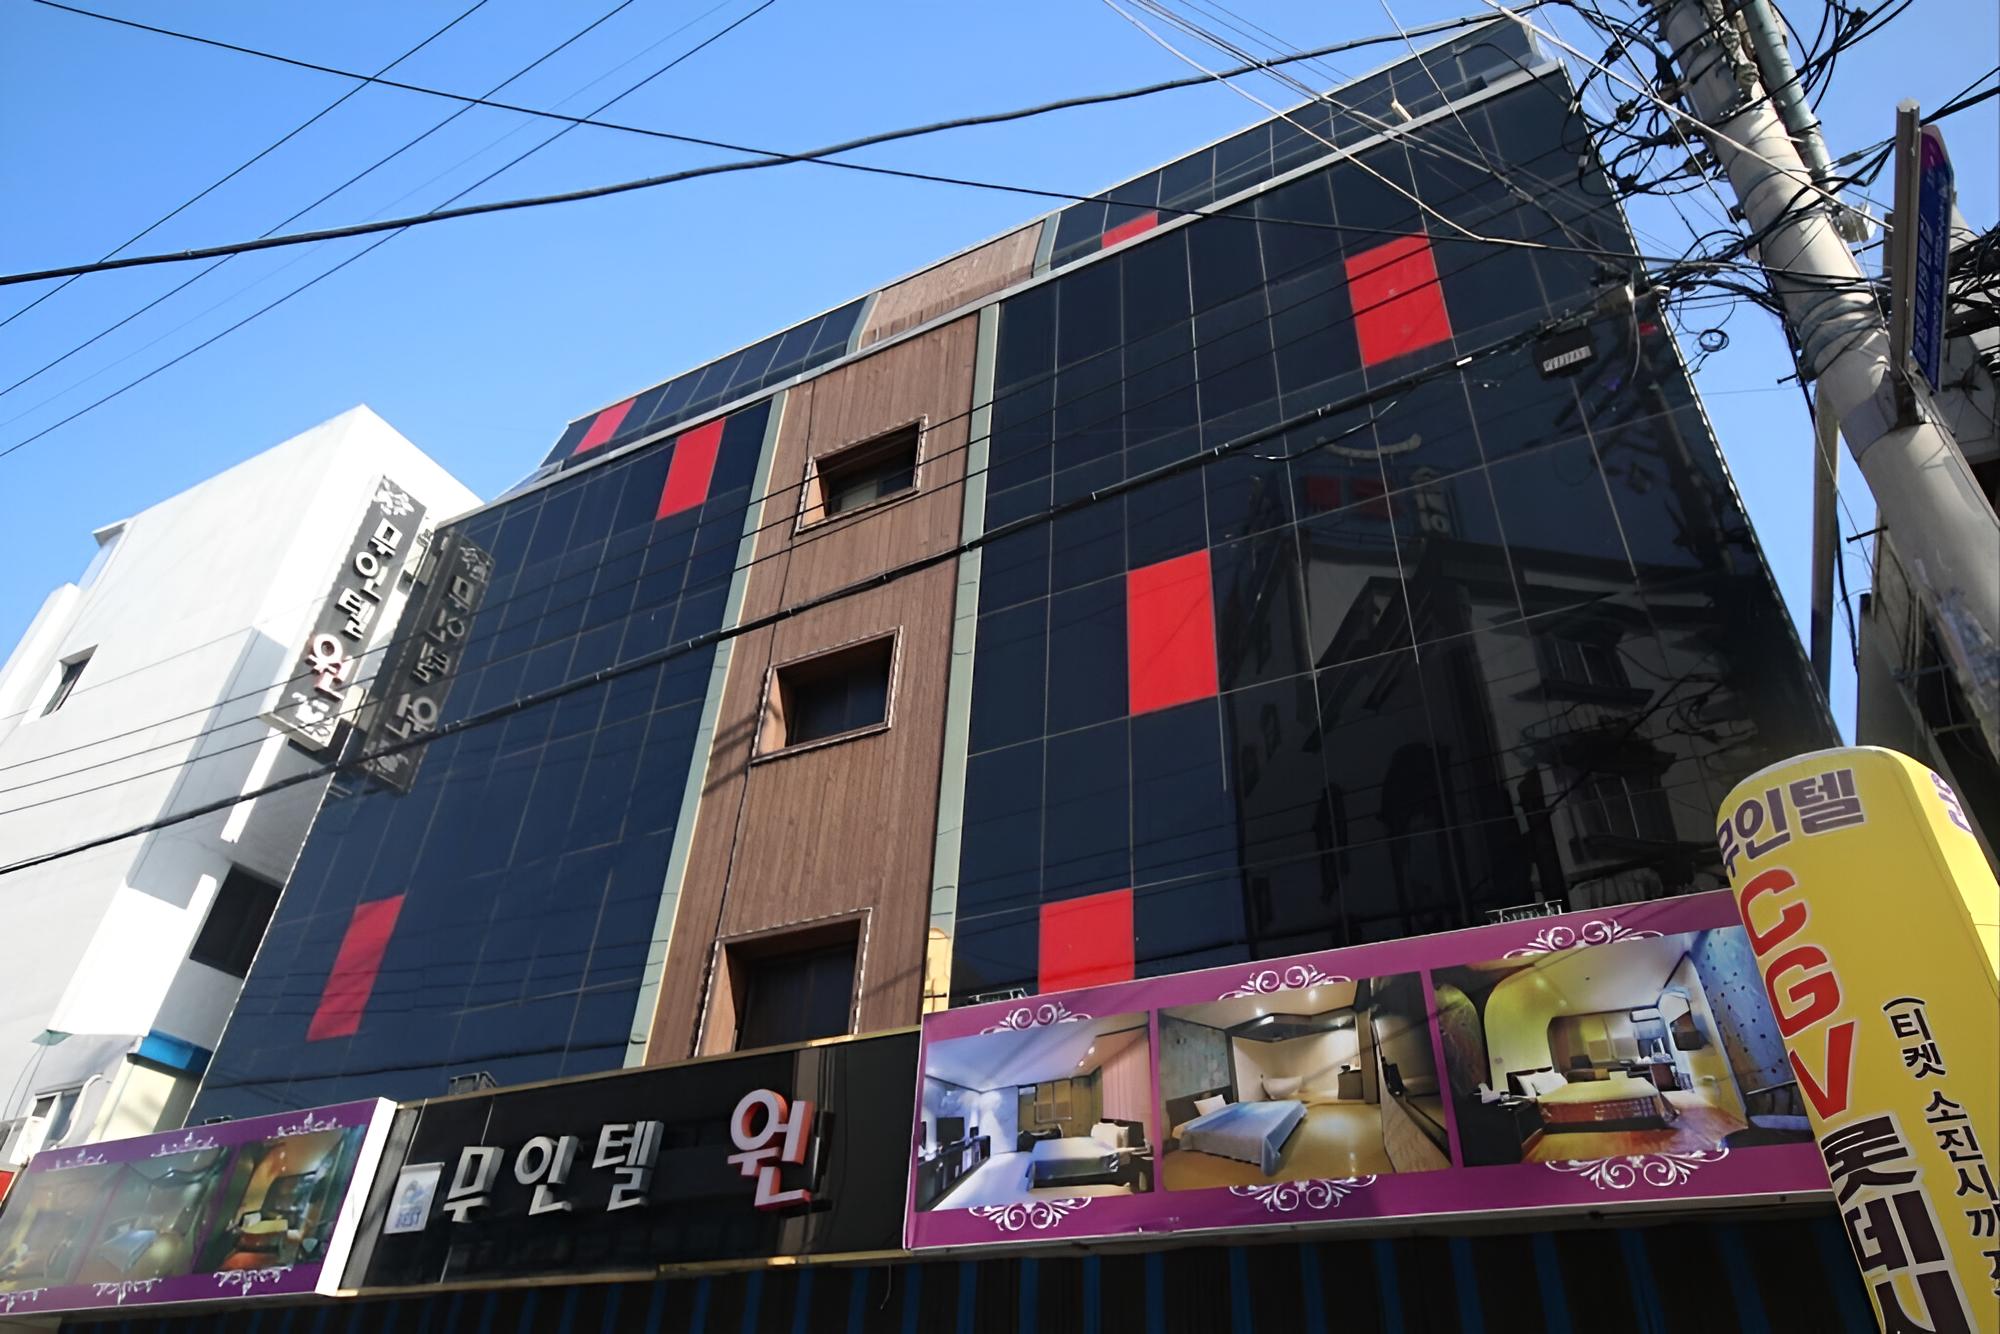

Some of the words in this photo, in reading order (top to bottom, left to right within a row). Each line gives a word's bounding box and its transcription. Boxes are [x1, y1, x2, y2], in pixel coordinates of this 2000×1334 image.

[336, 518, 403, 640] 무인텔
[305, 633, 354, 701] 원
[1718, 769, 1865, 878] 무인텔
[1740, 868, 1856, 1121] CGV
[1884, 997, 1946, 1078] (티켓
[443, 1120, 665, 1223] 무인텔
[727, 1088, 813, 1212] 원
